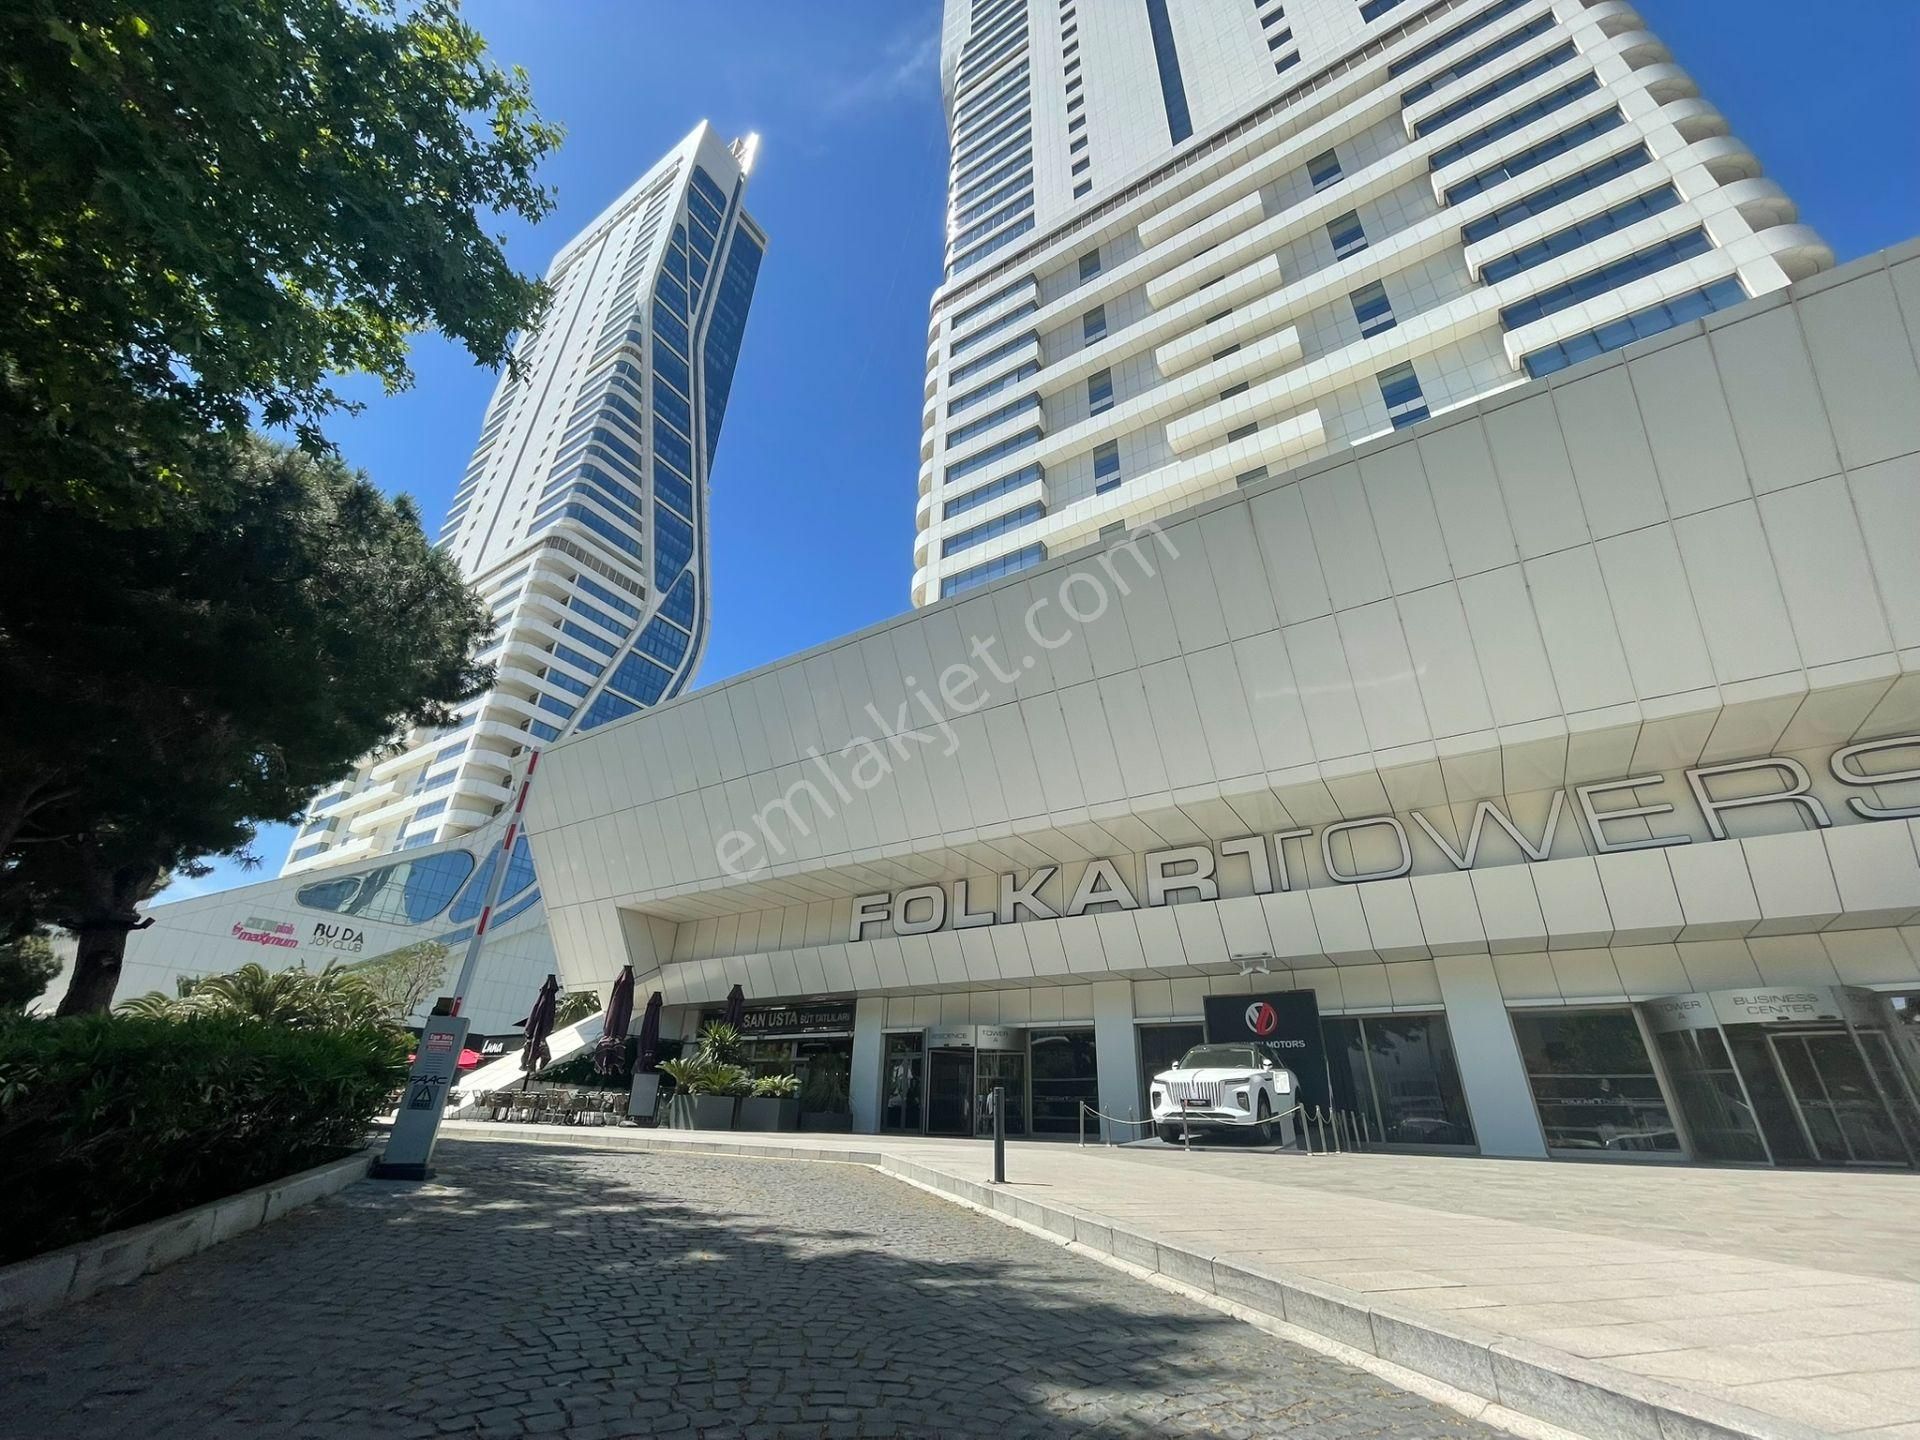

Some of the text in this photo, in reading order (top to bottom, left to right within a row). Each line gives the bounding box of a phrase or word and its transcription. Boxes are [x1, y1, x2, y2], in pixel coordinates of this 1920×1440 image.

[309, 936, 362, 952] JOY CLUB
[1733, 993, 1818, 1005] BUSINESS
[1746, 1004, 1815, 1014] CENTER
[743, 1012, 766, 1028] SAN
[768, 1011, 798, 1027] USTA
[982, 1029, 1009, 1037] TOWER
[1266, 1040, 1306, 1048] MOTORS
[410, 1075, 448, 1085] FAAC
